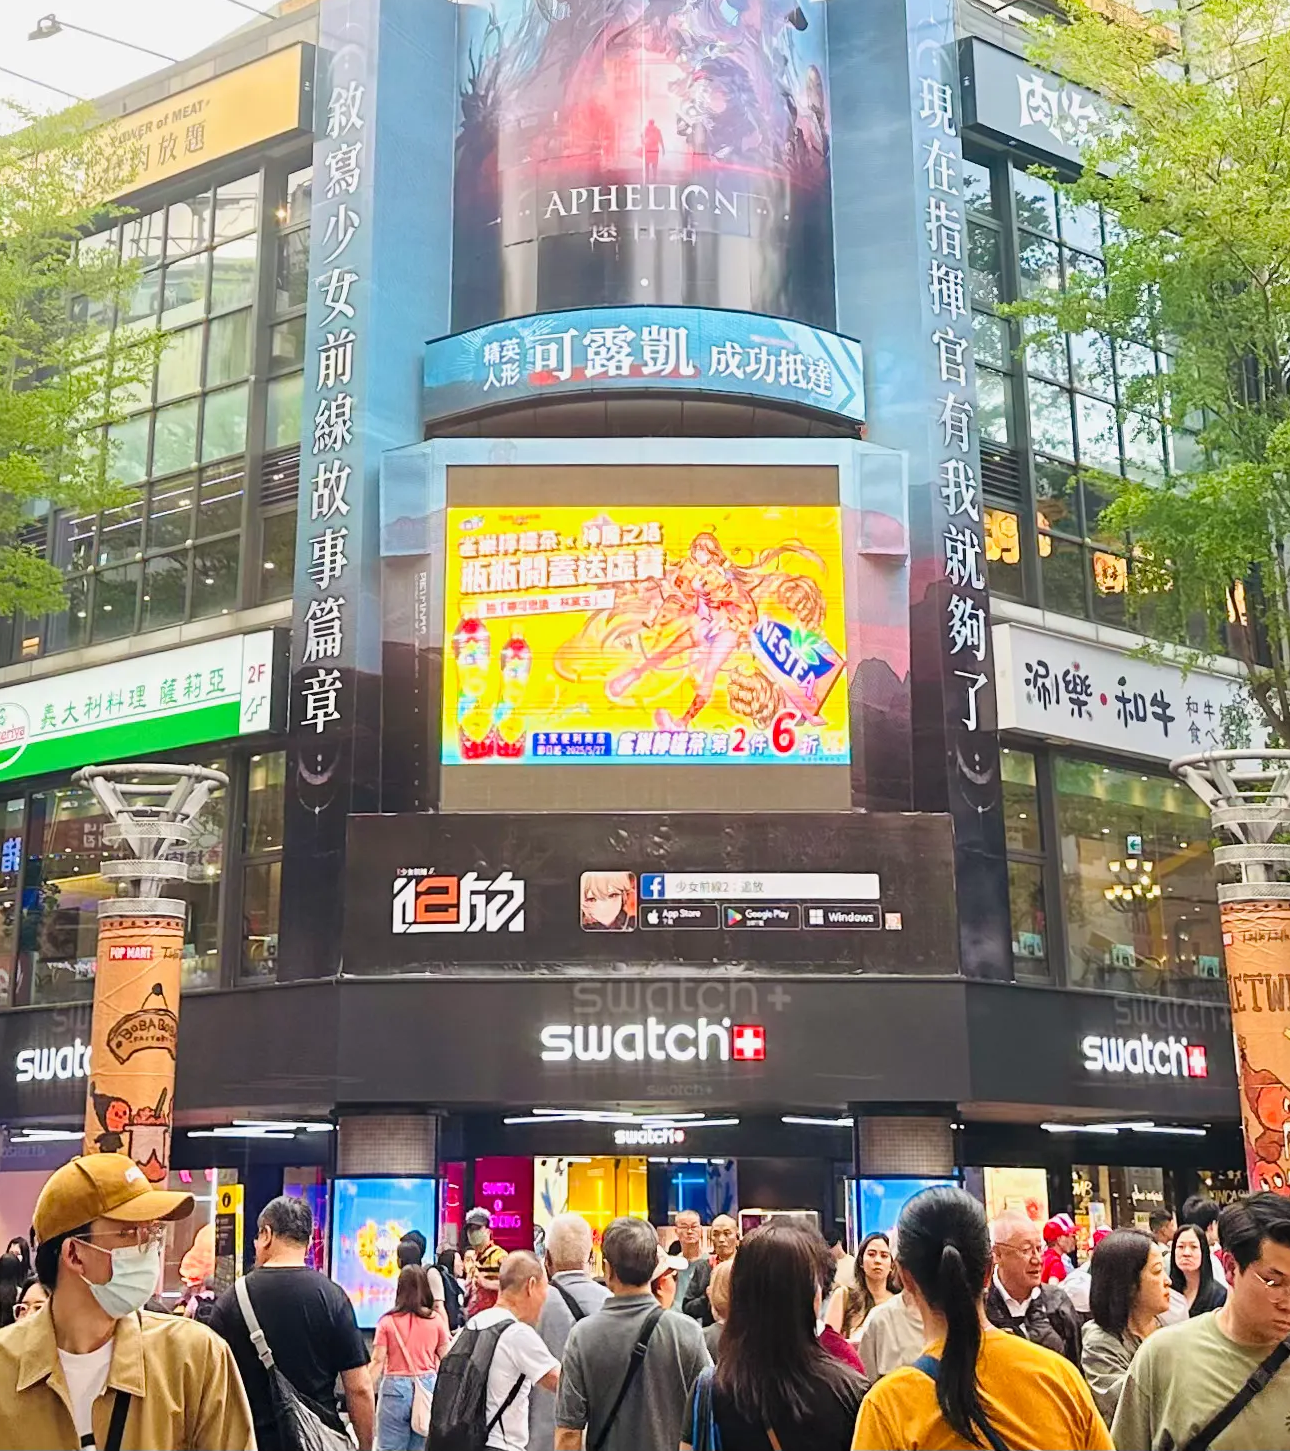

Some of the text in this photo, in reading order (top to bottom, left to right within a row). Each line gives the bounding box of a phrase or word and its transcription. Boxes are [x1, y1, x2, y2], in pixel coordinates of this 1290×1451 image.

[156, 114, 170, 132] of
[172, 99, 206, 124] MEAT
[543, 183, 738, 220] APHELION
[533, 324, 834, 398] 可露凱 成功抵達
[917, 75, 989, 732] 現在指揮官有我就夠了
[248, 664, 267, 685] 2F
[755, 620, 821, 700] NESTEA
[40, 684, 147, 731] 義大利料理
[662, 908, 702, 920] App Store
[745, 909, 790, 922] Google Play
[829, 911, 875, 924] Windows
[110, 945, 126, 960] POP
[126, 945, 152, 959] MART
[539, 1017, 731, 1062] swatch
[1082, 1033, 1190, 1077] swatch
[614, 1128, 675, 1146] swatch
